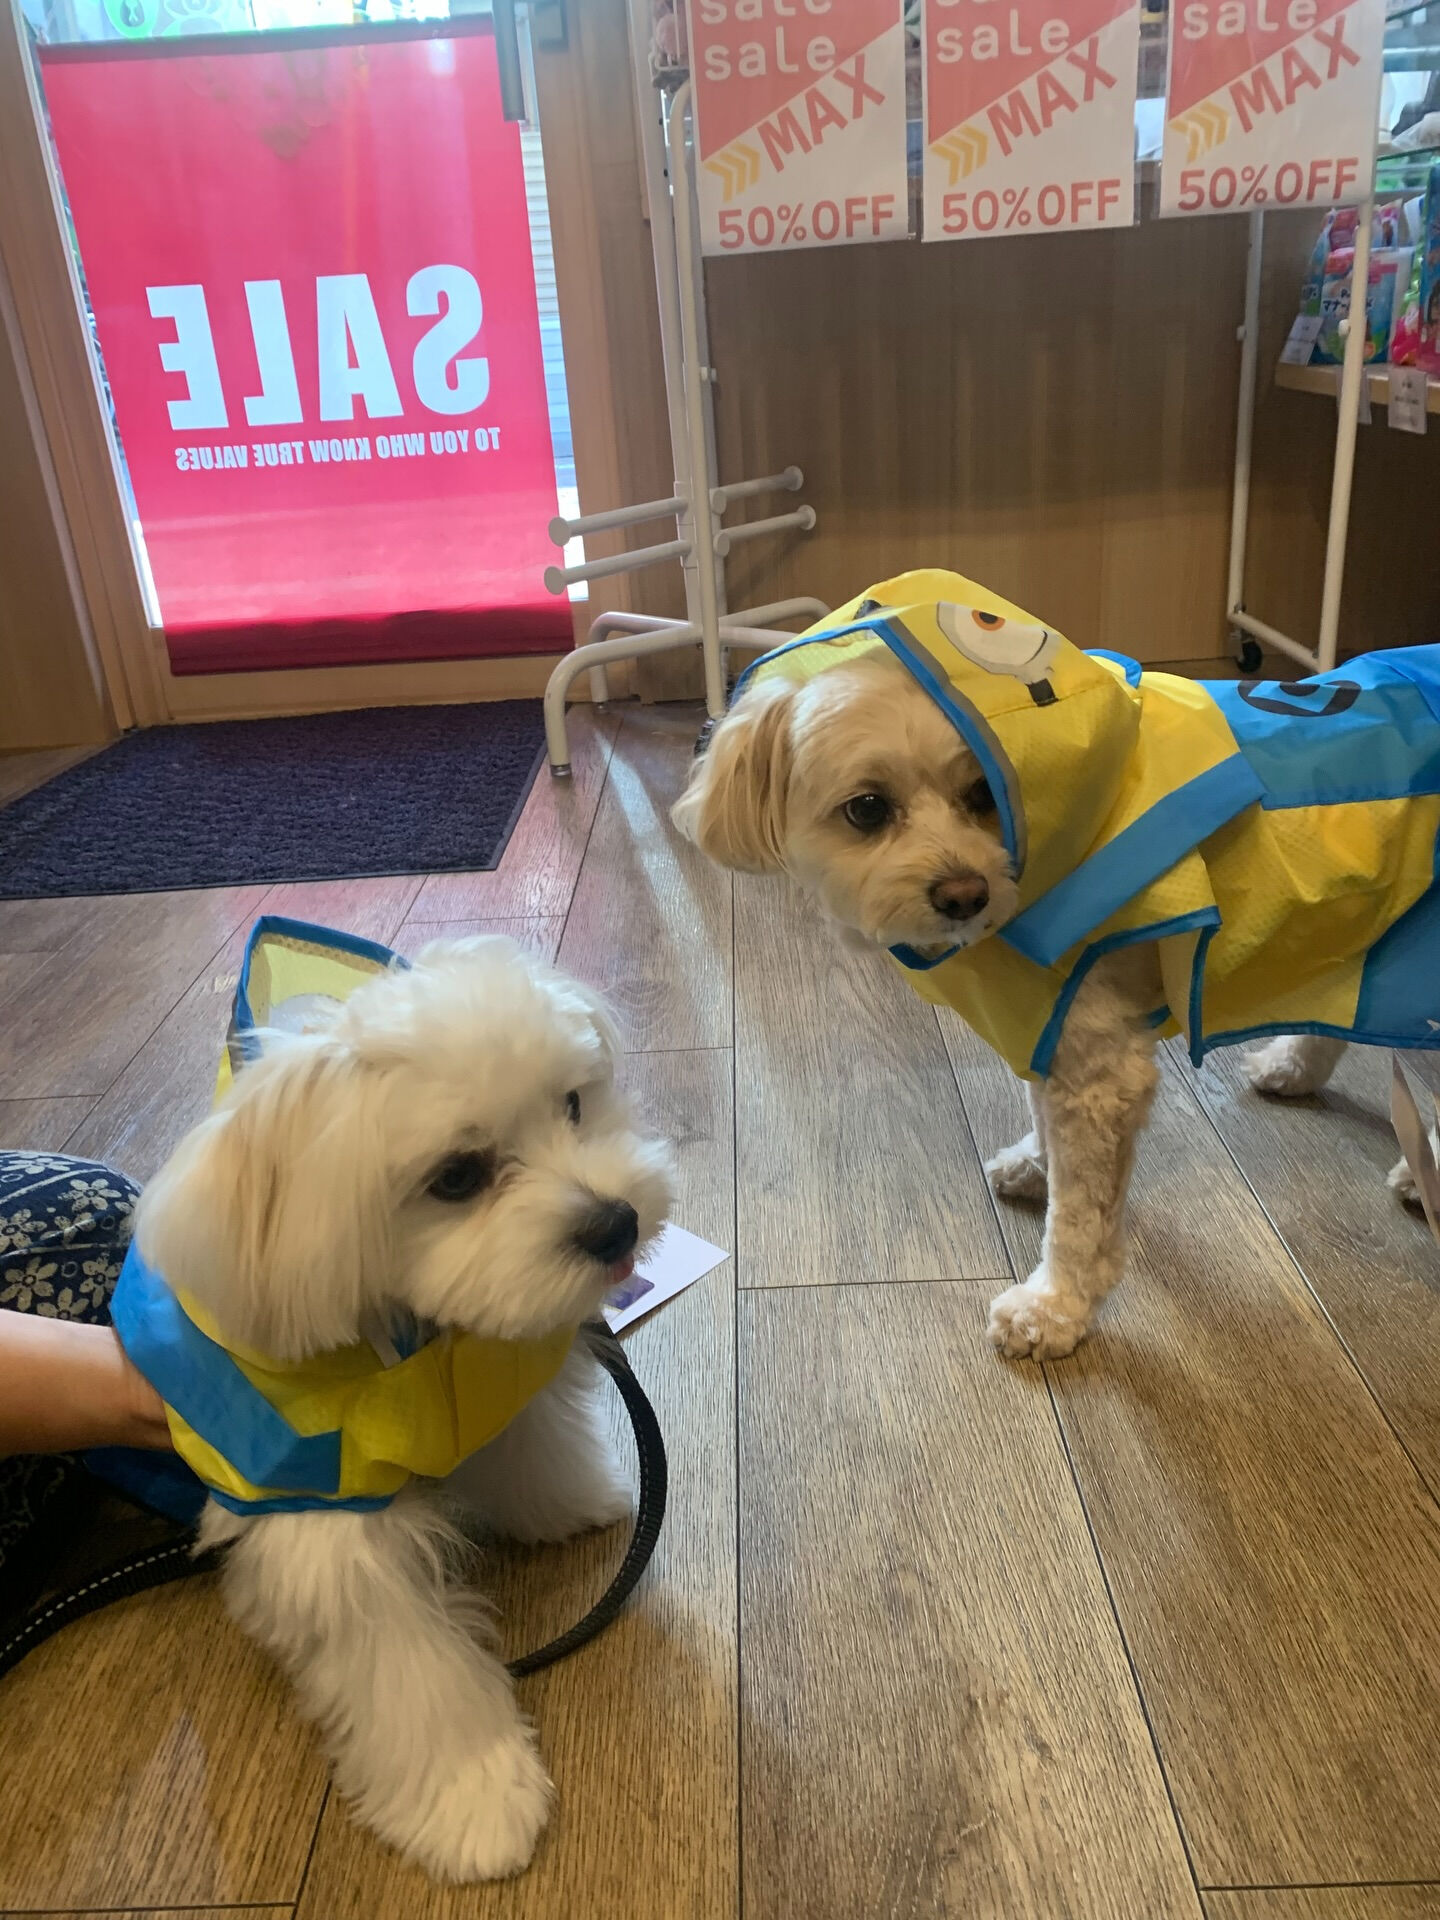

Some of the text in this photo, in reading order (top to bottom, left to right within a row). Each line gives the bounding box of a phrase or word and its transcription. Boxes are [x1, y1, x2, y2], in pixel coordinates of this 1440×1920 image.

[936, 8, 1070, 63] sale
[1182, 0, 1317, 39] sale
[704, 25, 836, 80] sale
[1229, 15, 1360, 133] MAX
[757, 53, 885, 172] MAX
[986, 36, 1117, 156] MAX
[942, 179, 1120, 233] 50%OFF
[1178, 157, 1358, 211] 50%OFF
[718, 194, 895, 249] 50%OFF
